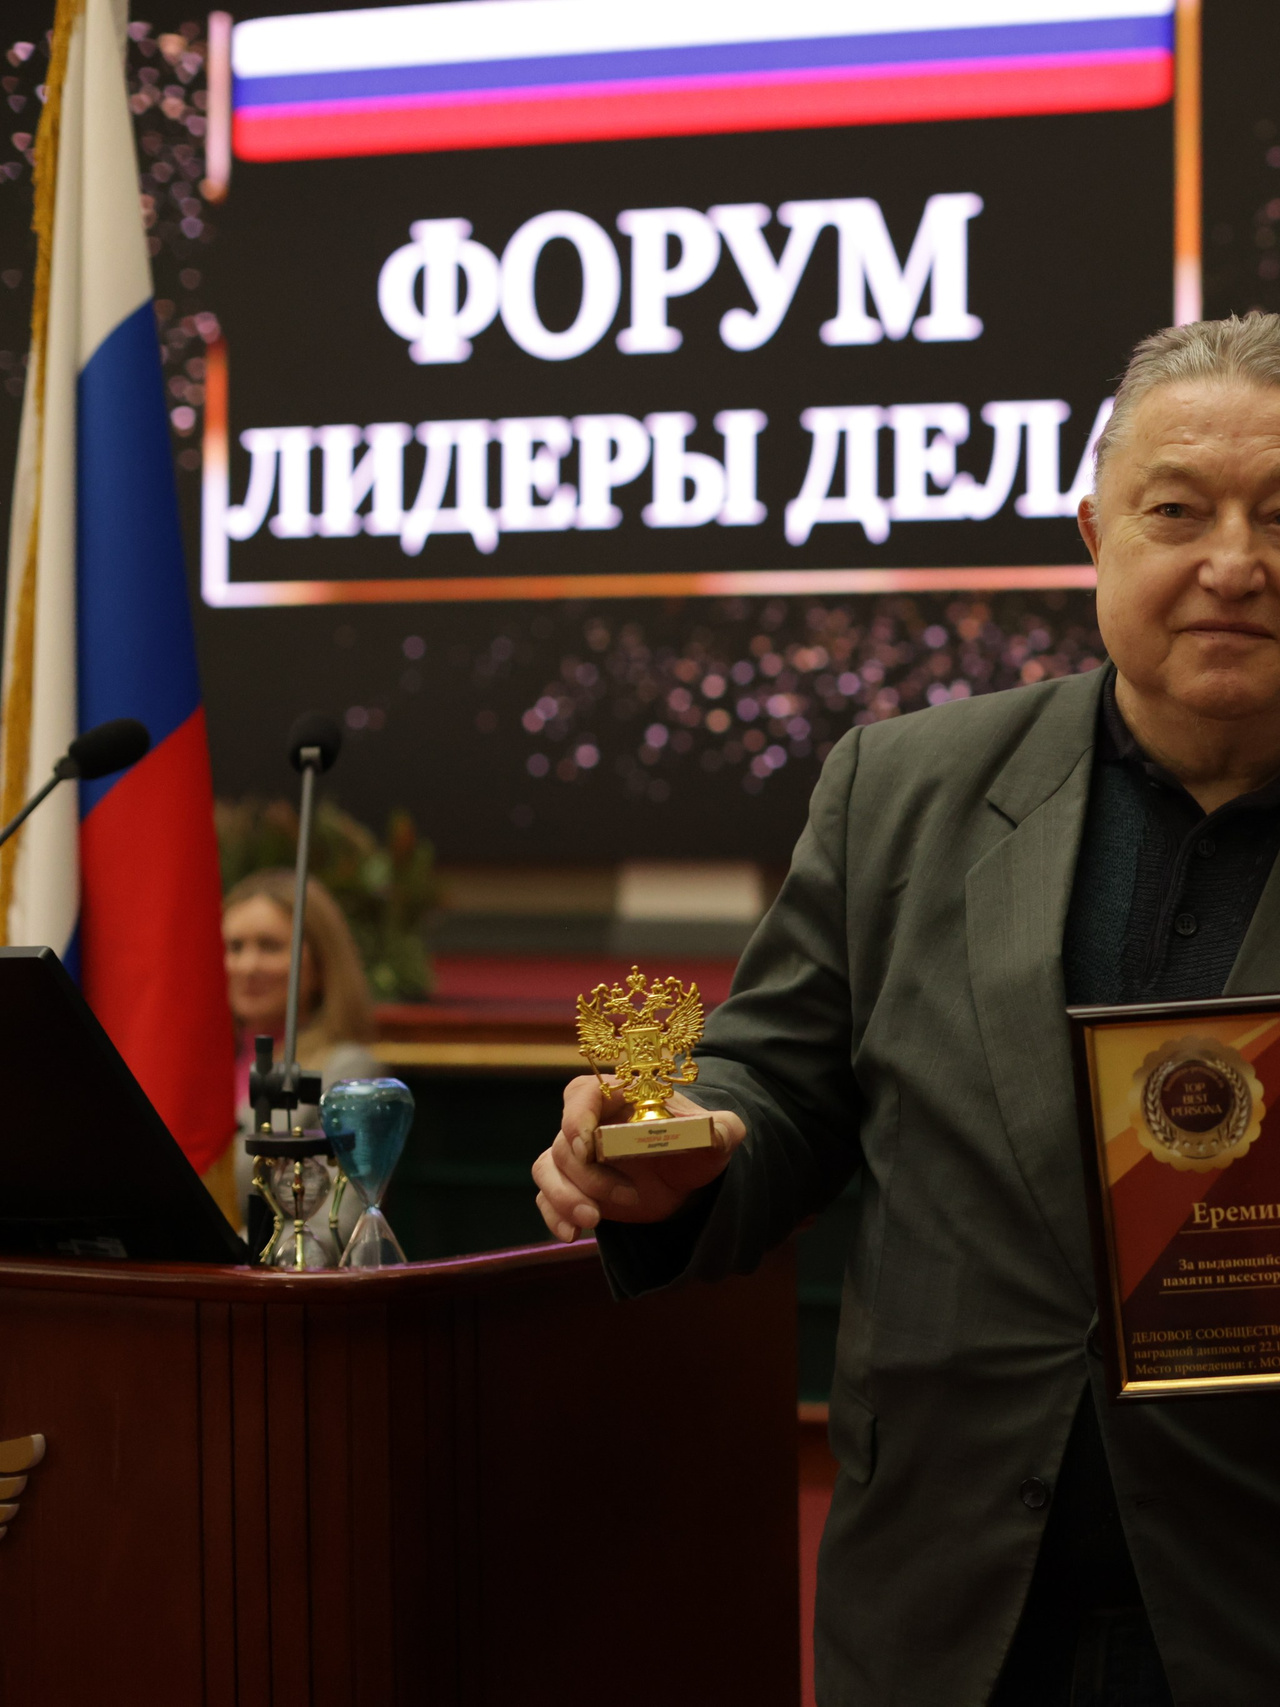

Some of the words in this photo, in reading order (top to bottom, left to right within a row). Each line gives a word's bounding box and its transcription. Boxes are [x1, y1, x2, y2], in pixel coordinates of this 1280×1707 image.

[377, 191, 985, 365] ФОРУМ
[227, 408, 768, 556] ЛИДЕРЫ
[1184, 1082, 1206, 1093] TOP
[1182, 1093, 1208, 1105] BEST
[1171, 1104, 1223, 1117] PERSONA
[1179, 1259, 1194, 1271] За
[1163, 1273, 1211, 1289] памяти
[1216, 1274, 1225, 1284] и
[1132, 1329, 1194, 1345] ДЕЛОВОЕ
[1134, 1345, 1194, 1361] наградной
[1196, 1343, 1241, 1358] диплом
[1243, 1343, 1257, 1353] от
[1136, 1363, 1172, 1376] Место
[1174, 1359, 1246, 1375] проведения:
[1248, 1360, 1257, 1370] г.
